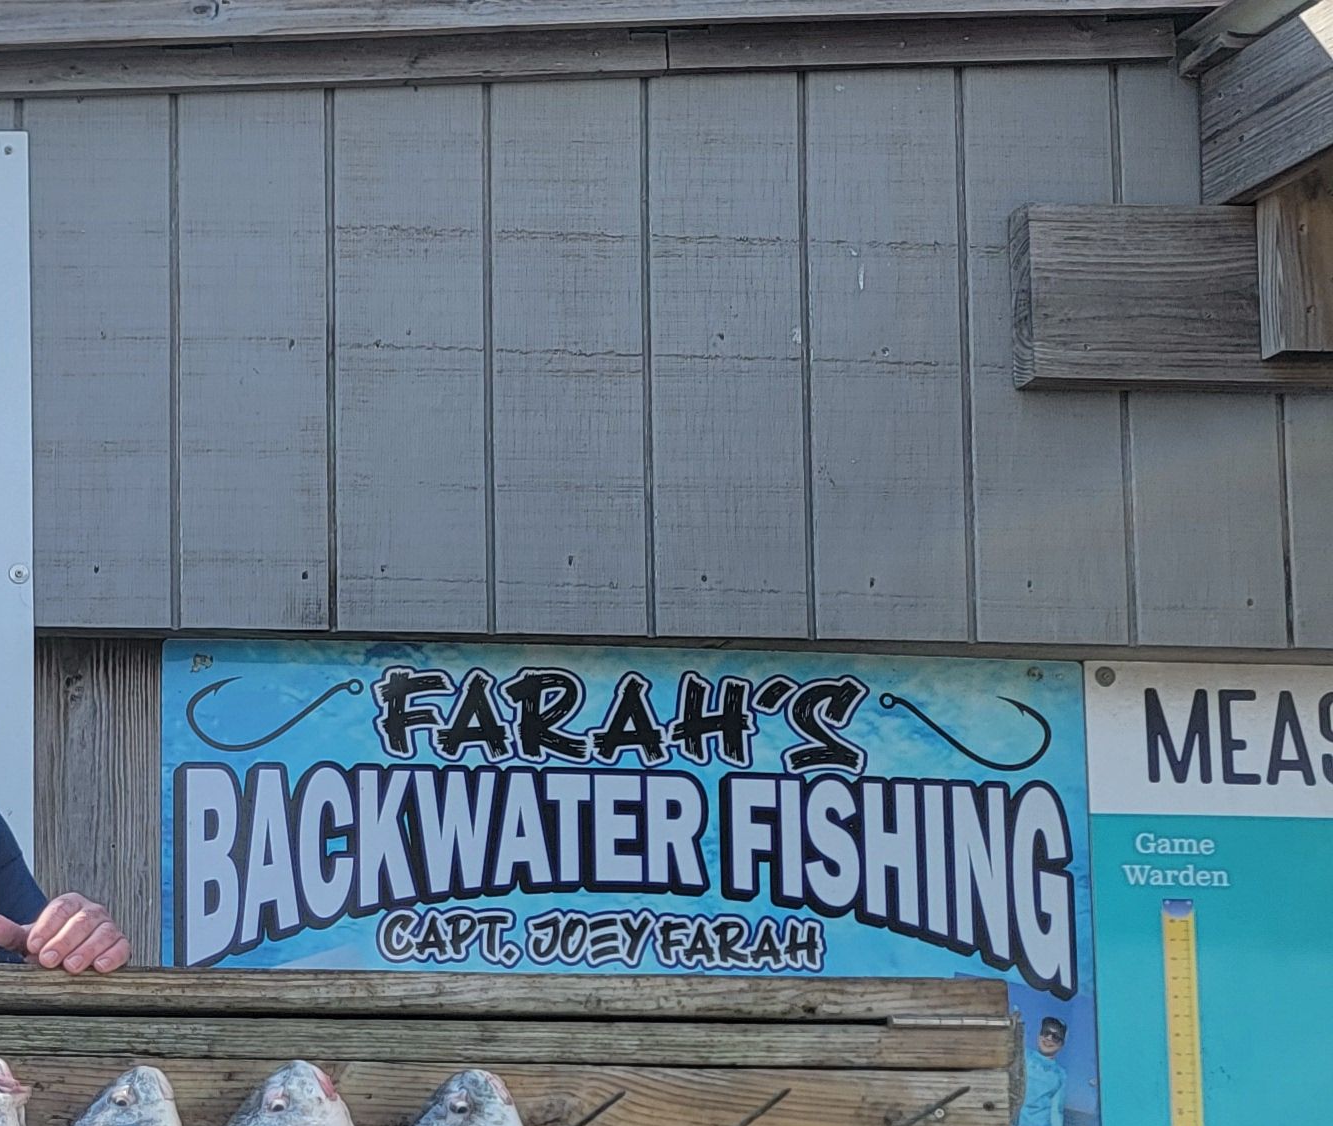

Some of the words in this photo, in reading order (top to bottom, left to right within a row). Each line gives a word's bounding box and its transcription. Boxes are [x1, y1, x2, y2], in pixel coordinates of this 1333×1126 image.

[375, 669, 865, 773] FARAH'S
[1135, 832, 1215, 855] Game
[184, 765, 704, 966] BACKWATER
[730, 776, 1073, 991] FISHING
[1121, 863, 1231, 886] Warden
[382, 912, 519, 965] CAPT.
[531, 913, 653, 966] JOEY
[656, 918, 825, 969] FARAH
